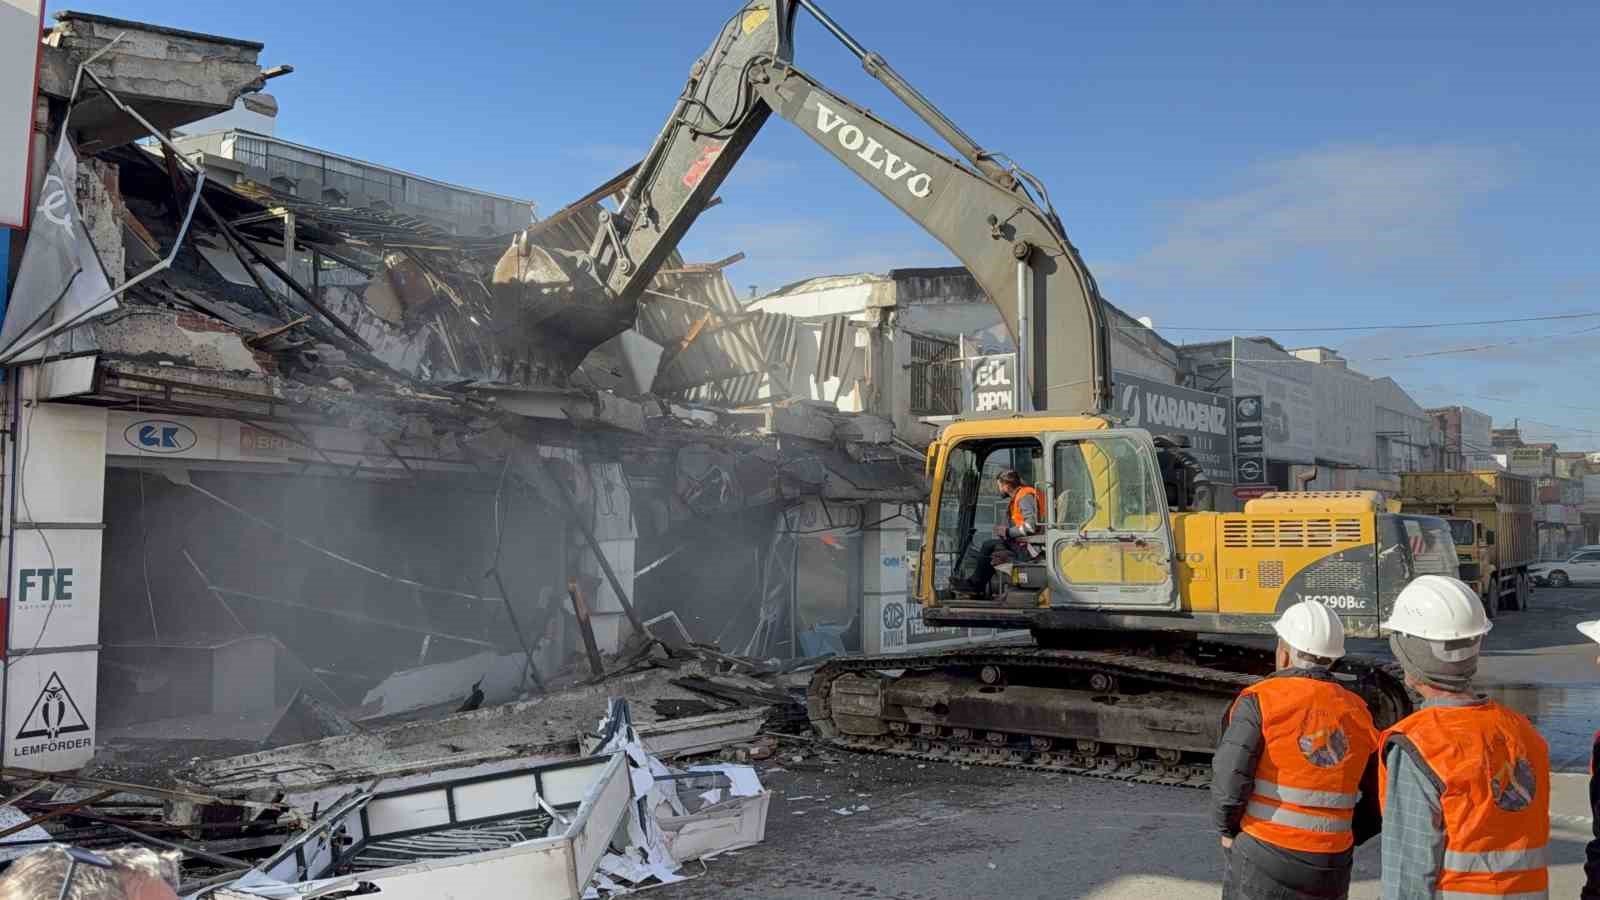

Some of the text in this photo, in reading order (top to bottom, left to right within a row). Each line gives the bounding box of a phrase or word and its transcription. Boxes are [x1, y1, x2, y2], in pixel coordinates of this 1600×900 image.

[816, 102, 931, 198] VOLVO
[1146, 392, 1227, 435] KARADENİZ
[19, 568, 73, 601] FTE
[15, 739, 91, 756] LEMFÖRDER
